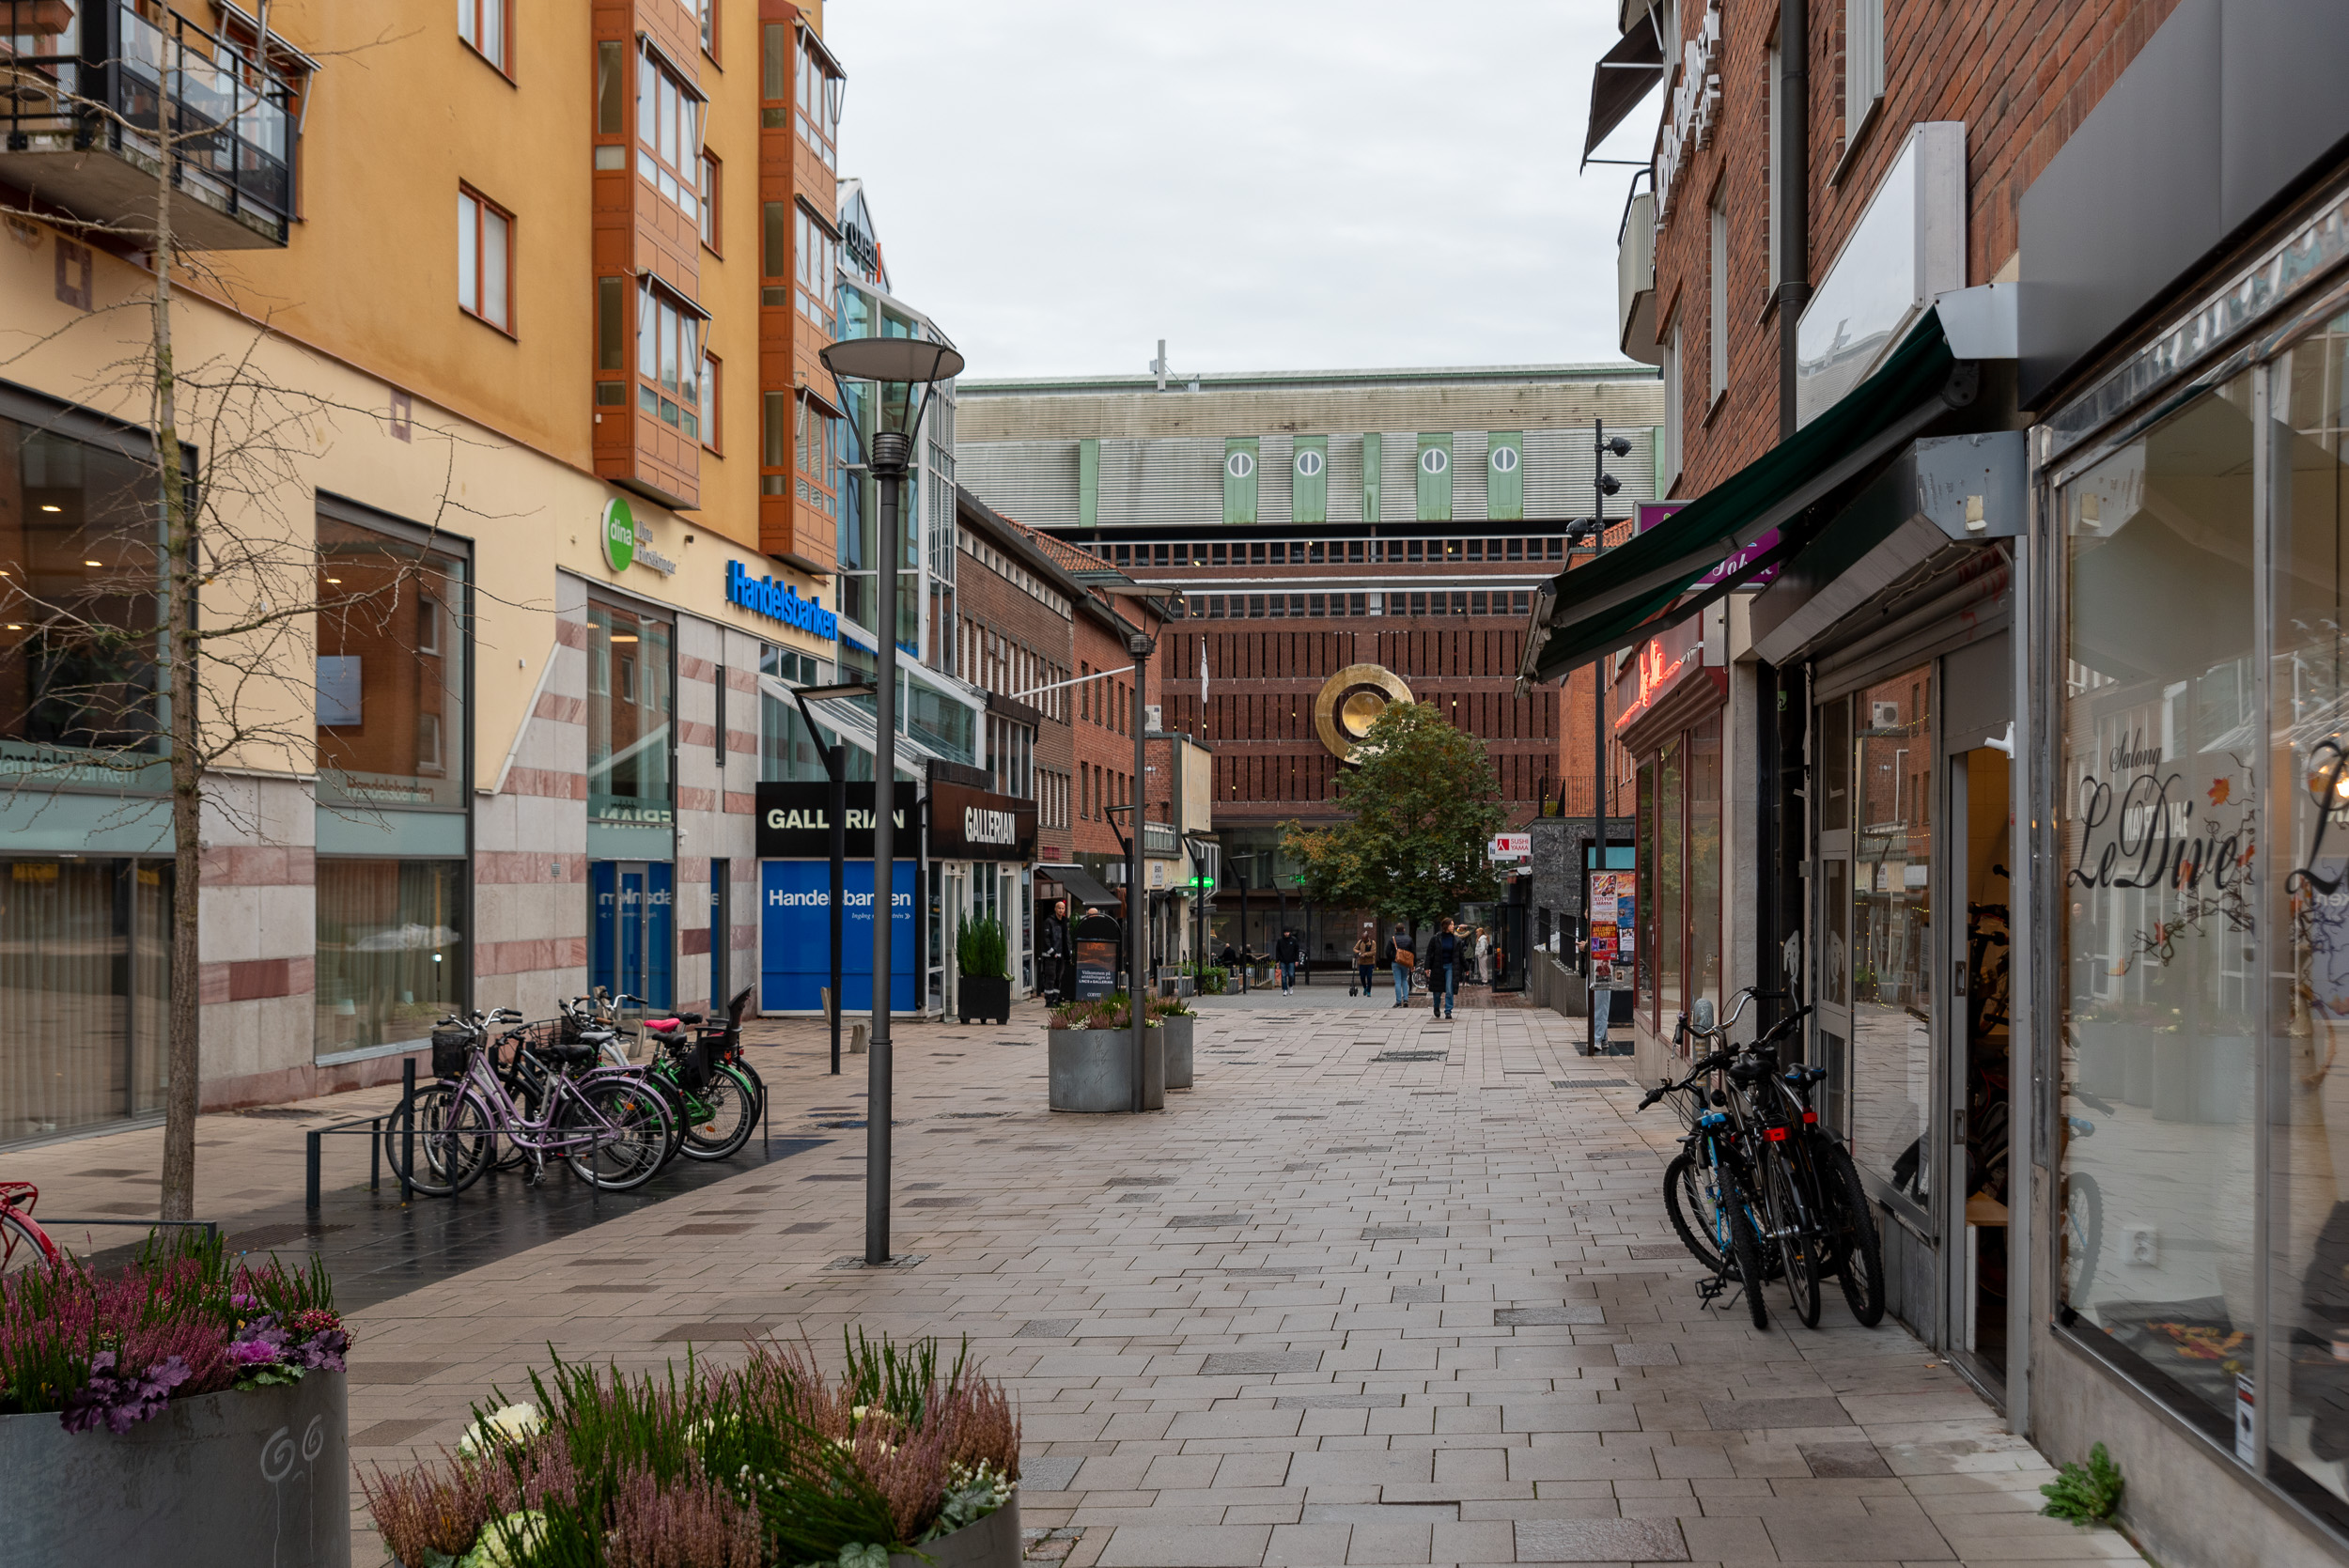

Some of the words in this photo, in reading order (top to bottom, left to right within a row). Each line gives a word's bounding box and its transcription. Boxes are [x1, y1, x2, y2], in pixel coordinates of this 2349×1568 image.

[610, 518, 632, 546] dina
[728, 560, 837, 642] Handelsbanken
[2109, 728, 2162, 800] Salong
[767, 809, 905, 830] GALLRIN
[965, 806, 1015, 845] GALLERIAN
